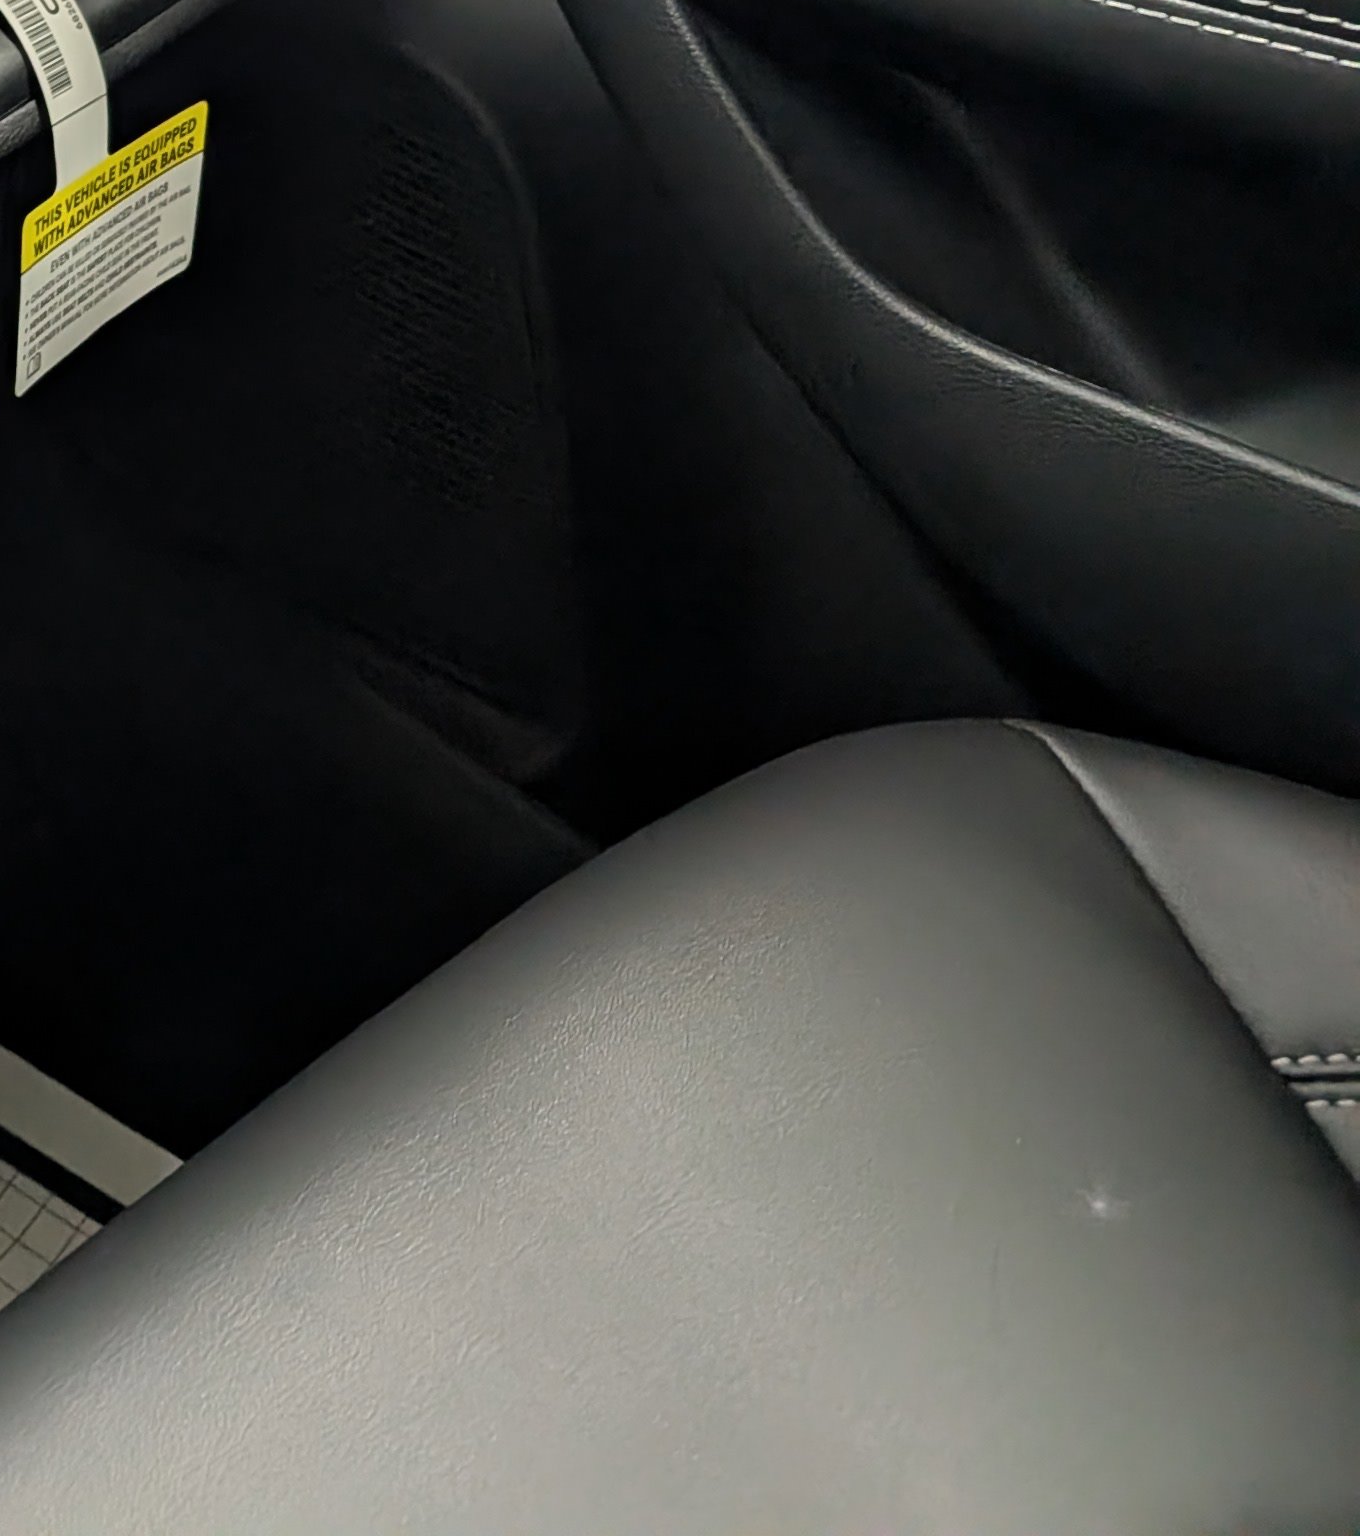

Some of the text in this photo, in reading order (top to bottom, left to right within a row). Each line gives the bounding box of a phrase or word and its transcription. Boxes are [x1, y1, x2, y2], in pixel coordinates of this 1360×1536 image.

[33, 137, 195, 258] WITH ADVANCED AIR BAGS
[34, 117, 197, 236] THIS VEHICLE IS EQUIPPED
